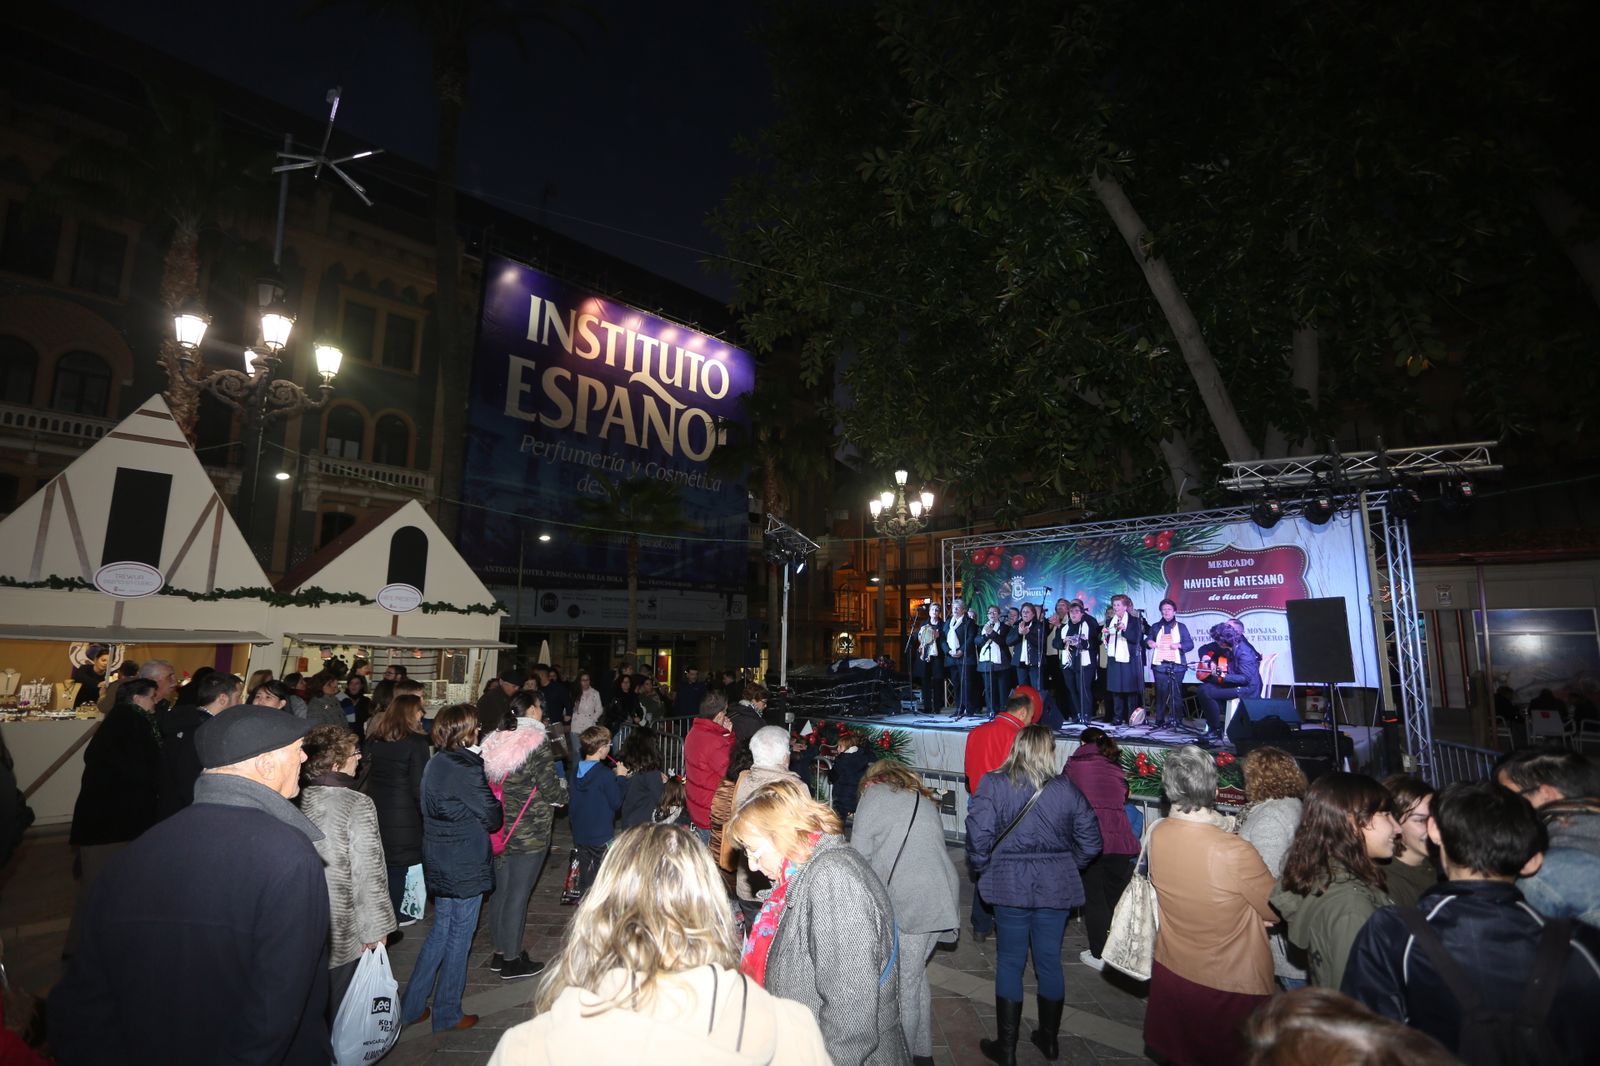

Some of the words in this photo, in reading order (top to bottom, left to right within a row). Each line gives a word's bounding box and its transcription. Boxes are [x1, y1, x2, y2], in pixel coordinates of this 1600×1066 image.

[526, 293, 730, 401] INSTITUTO
[519, 434, 625, 473] Perfumería
[1207, 558, 1255, 569] MERCADO
[1183, 575, 1230, 589] NAVIDEÑO
[1233, 573, 1285, 587] ARTESANO
[1208, 593, 1221, 601] de
[1221, 592, 1259, 601] Huelva
[1257, 634, 1283, 642] ENERO
[372, 1000, 390, 1012] Lee
